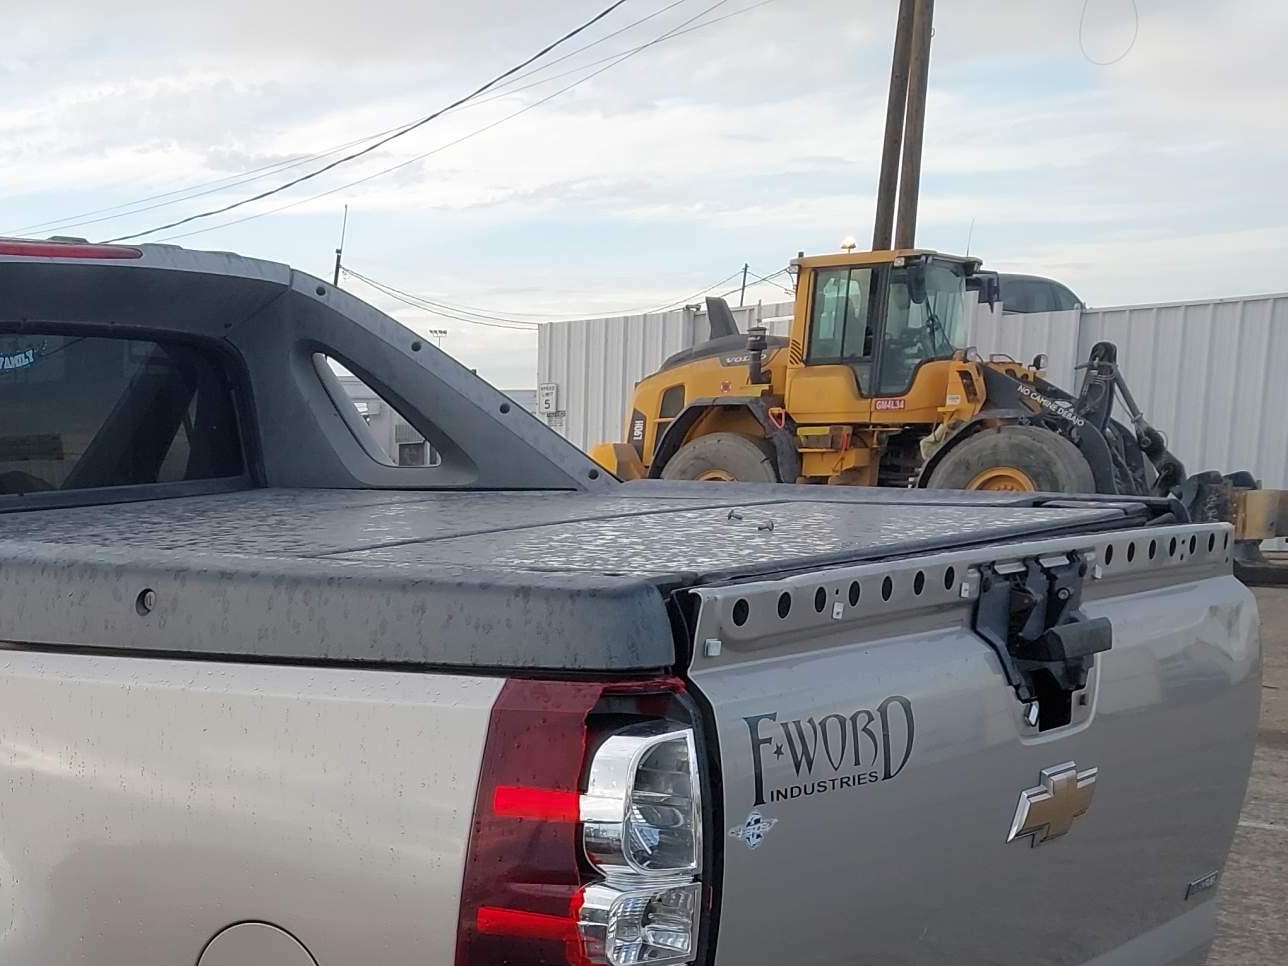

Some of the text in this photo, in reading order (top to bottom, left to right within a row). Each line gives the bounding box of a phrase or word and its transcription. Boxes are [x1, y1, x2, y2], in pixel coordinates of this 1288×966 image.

[726, 352, 767, 363] VOLO
[1017, 384, 1031, 396] NO
[544, 399, 551, 410] 5
[632, 420, 644, 441] L90H
[770, 770, 879, 804] INDUSTRIES
